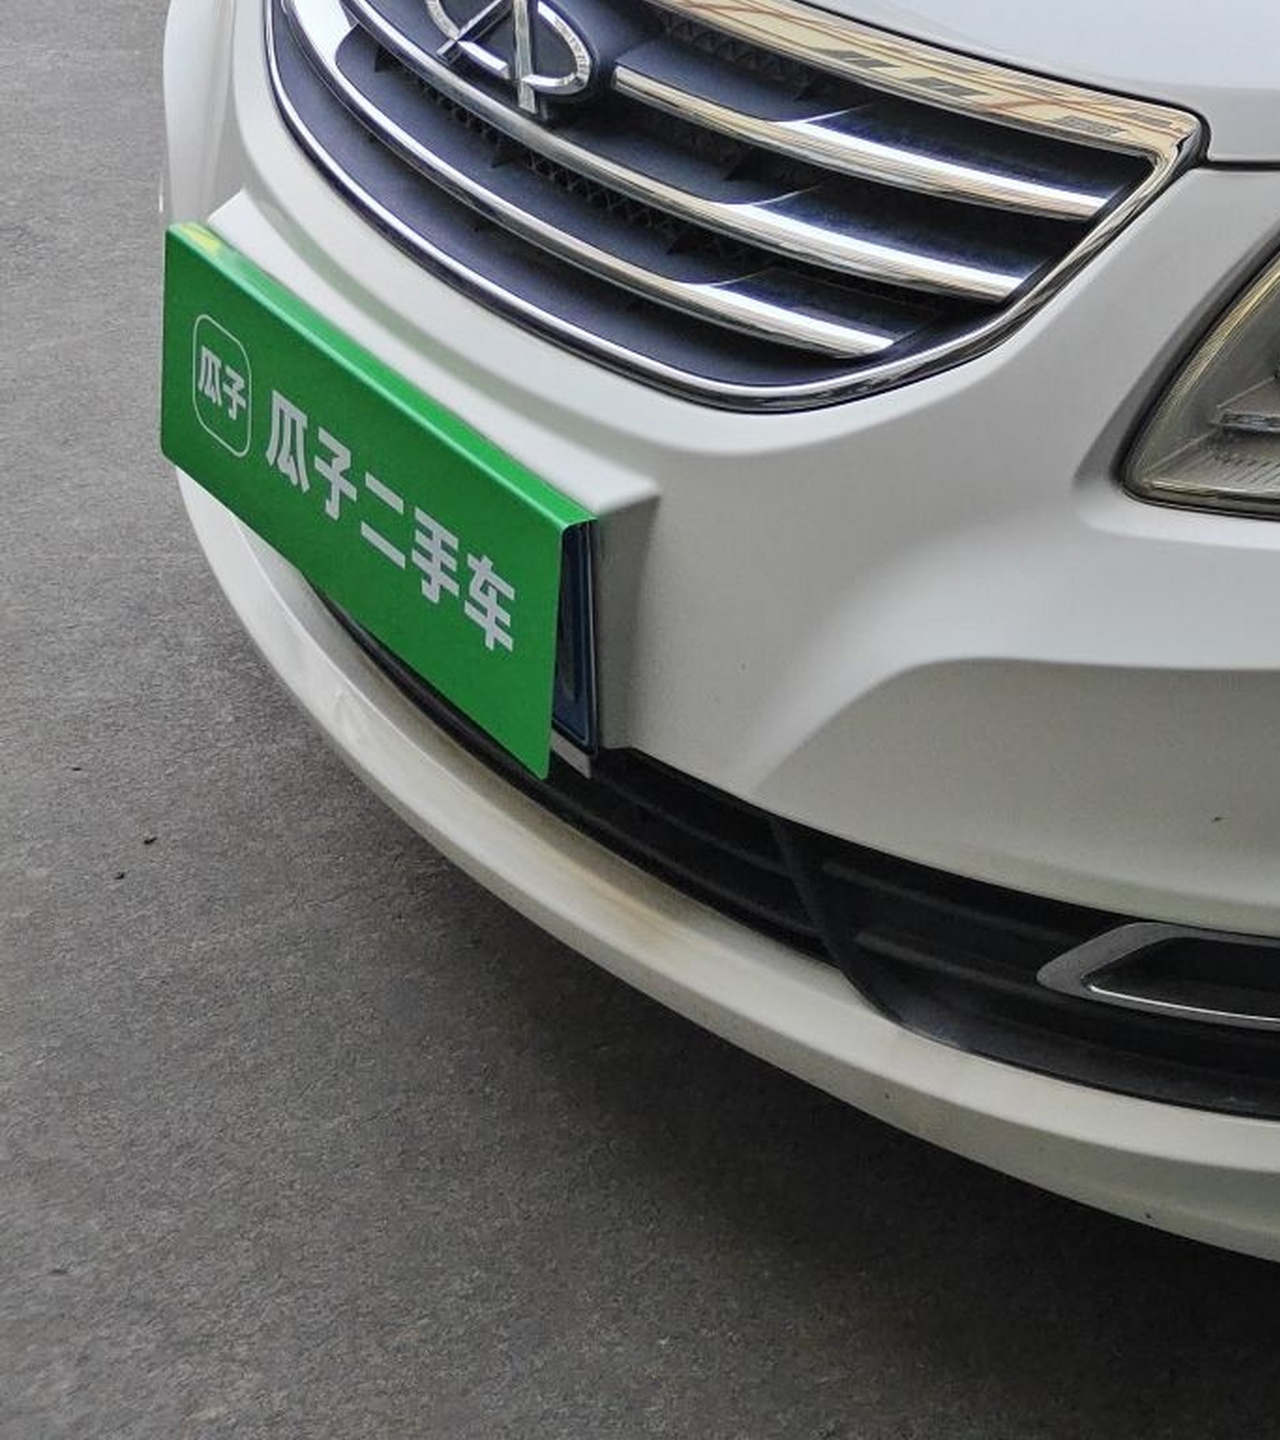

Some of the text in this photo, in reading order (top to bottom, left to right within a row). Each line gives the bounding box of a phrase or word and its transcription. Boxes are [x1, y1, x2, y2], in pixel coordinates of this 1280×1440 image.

[199, 346, 247, 420] 瓜子
[266, 390, 515, 652] 瓜子二手车
